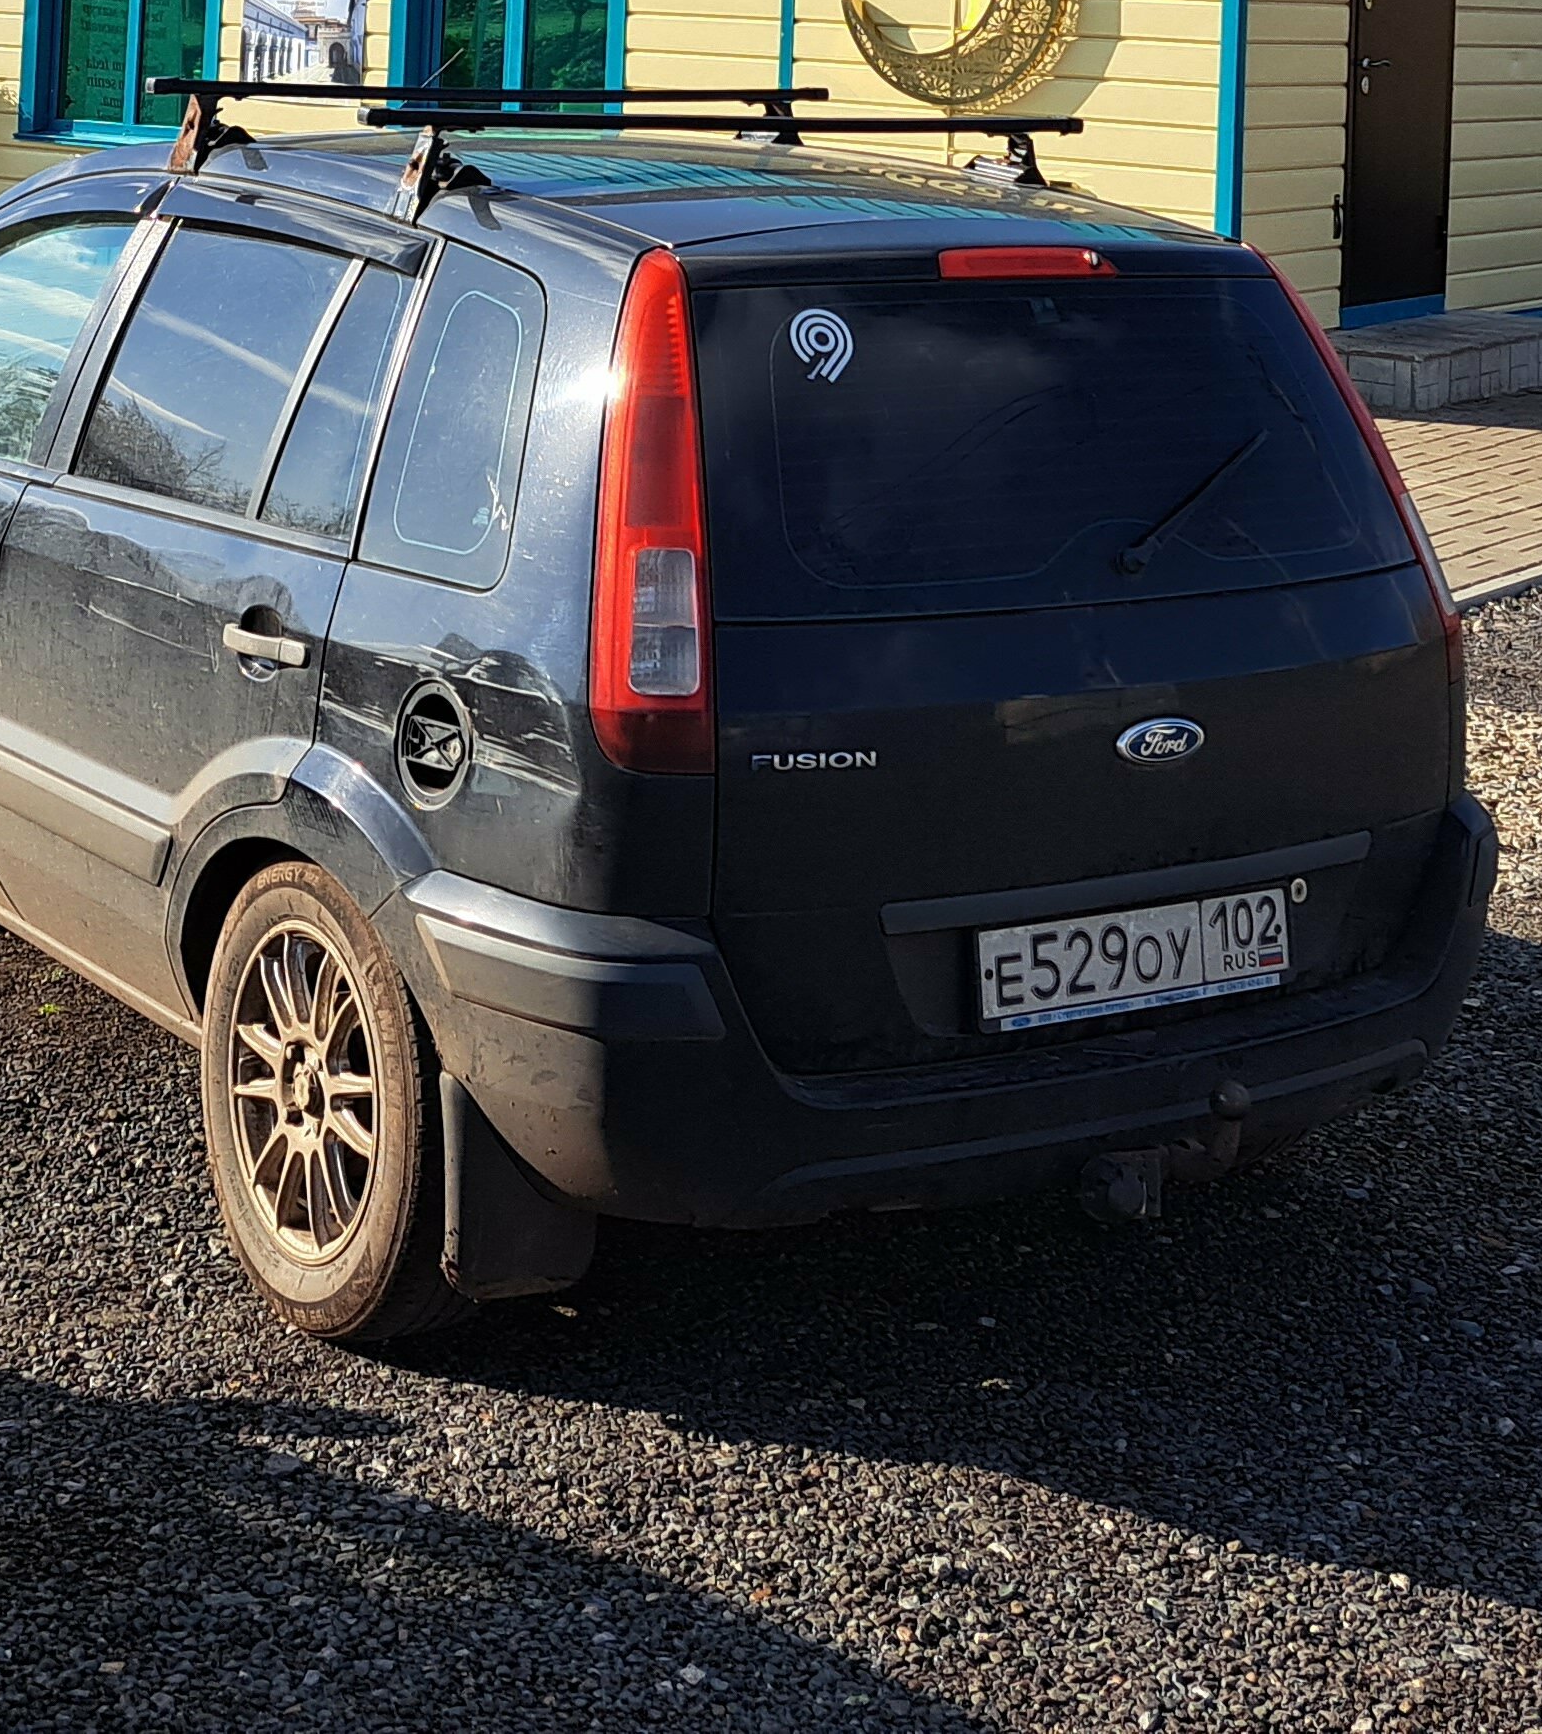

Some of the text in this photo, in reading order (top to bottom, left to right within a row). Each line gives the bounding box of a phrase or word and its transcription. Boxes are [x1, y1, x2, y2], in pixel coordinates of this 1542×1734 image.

[1140, 727, 1189, 757] Ford
[751, 750, 878, 771] FUSION
[1209, 895, 1278, 953] 102
[1222, 951, 1258, 972] RUS
